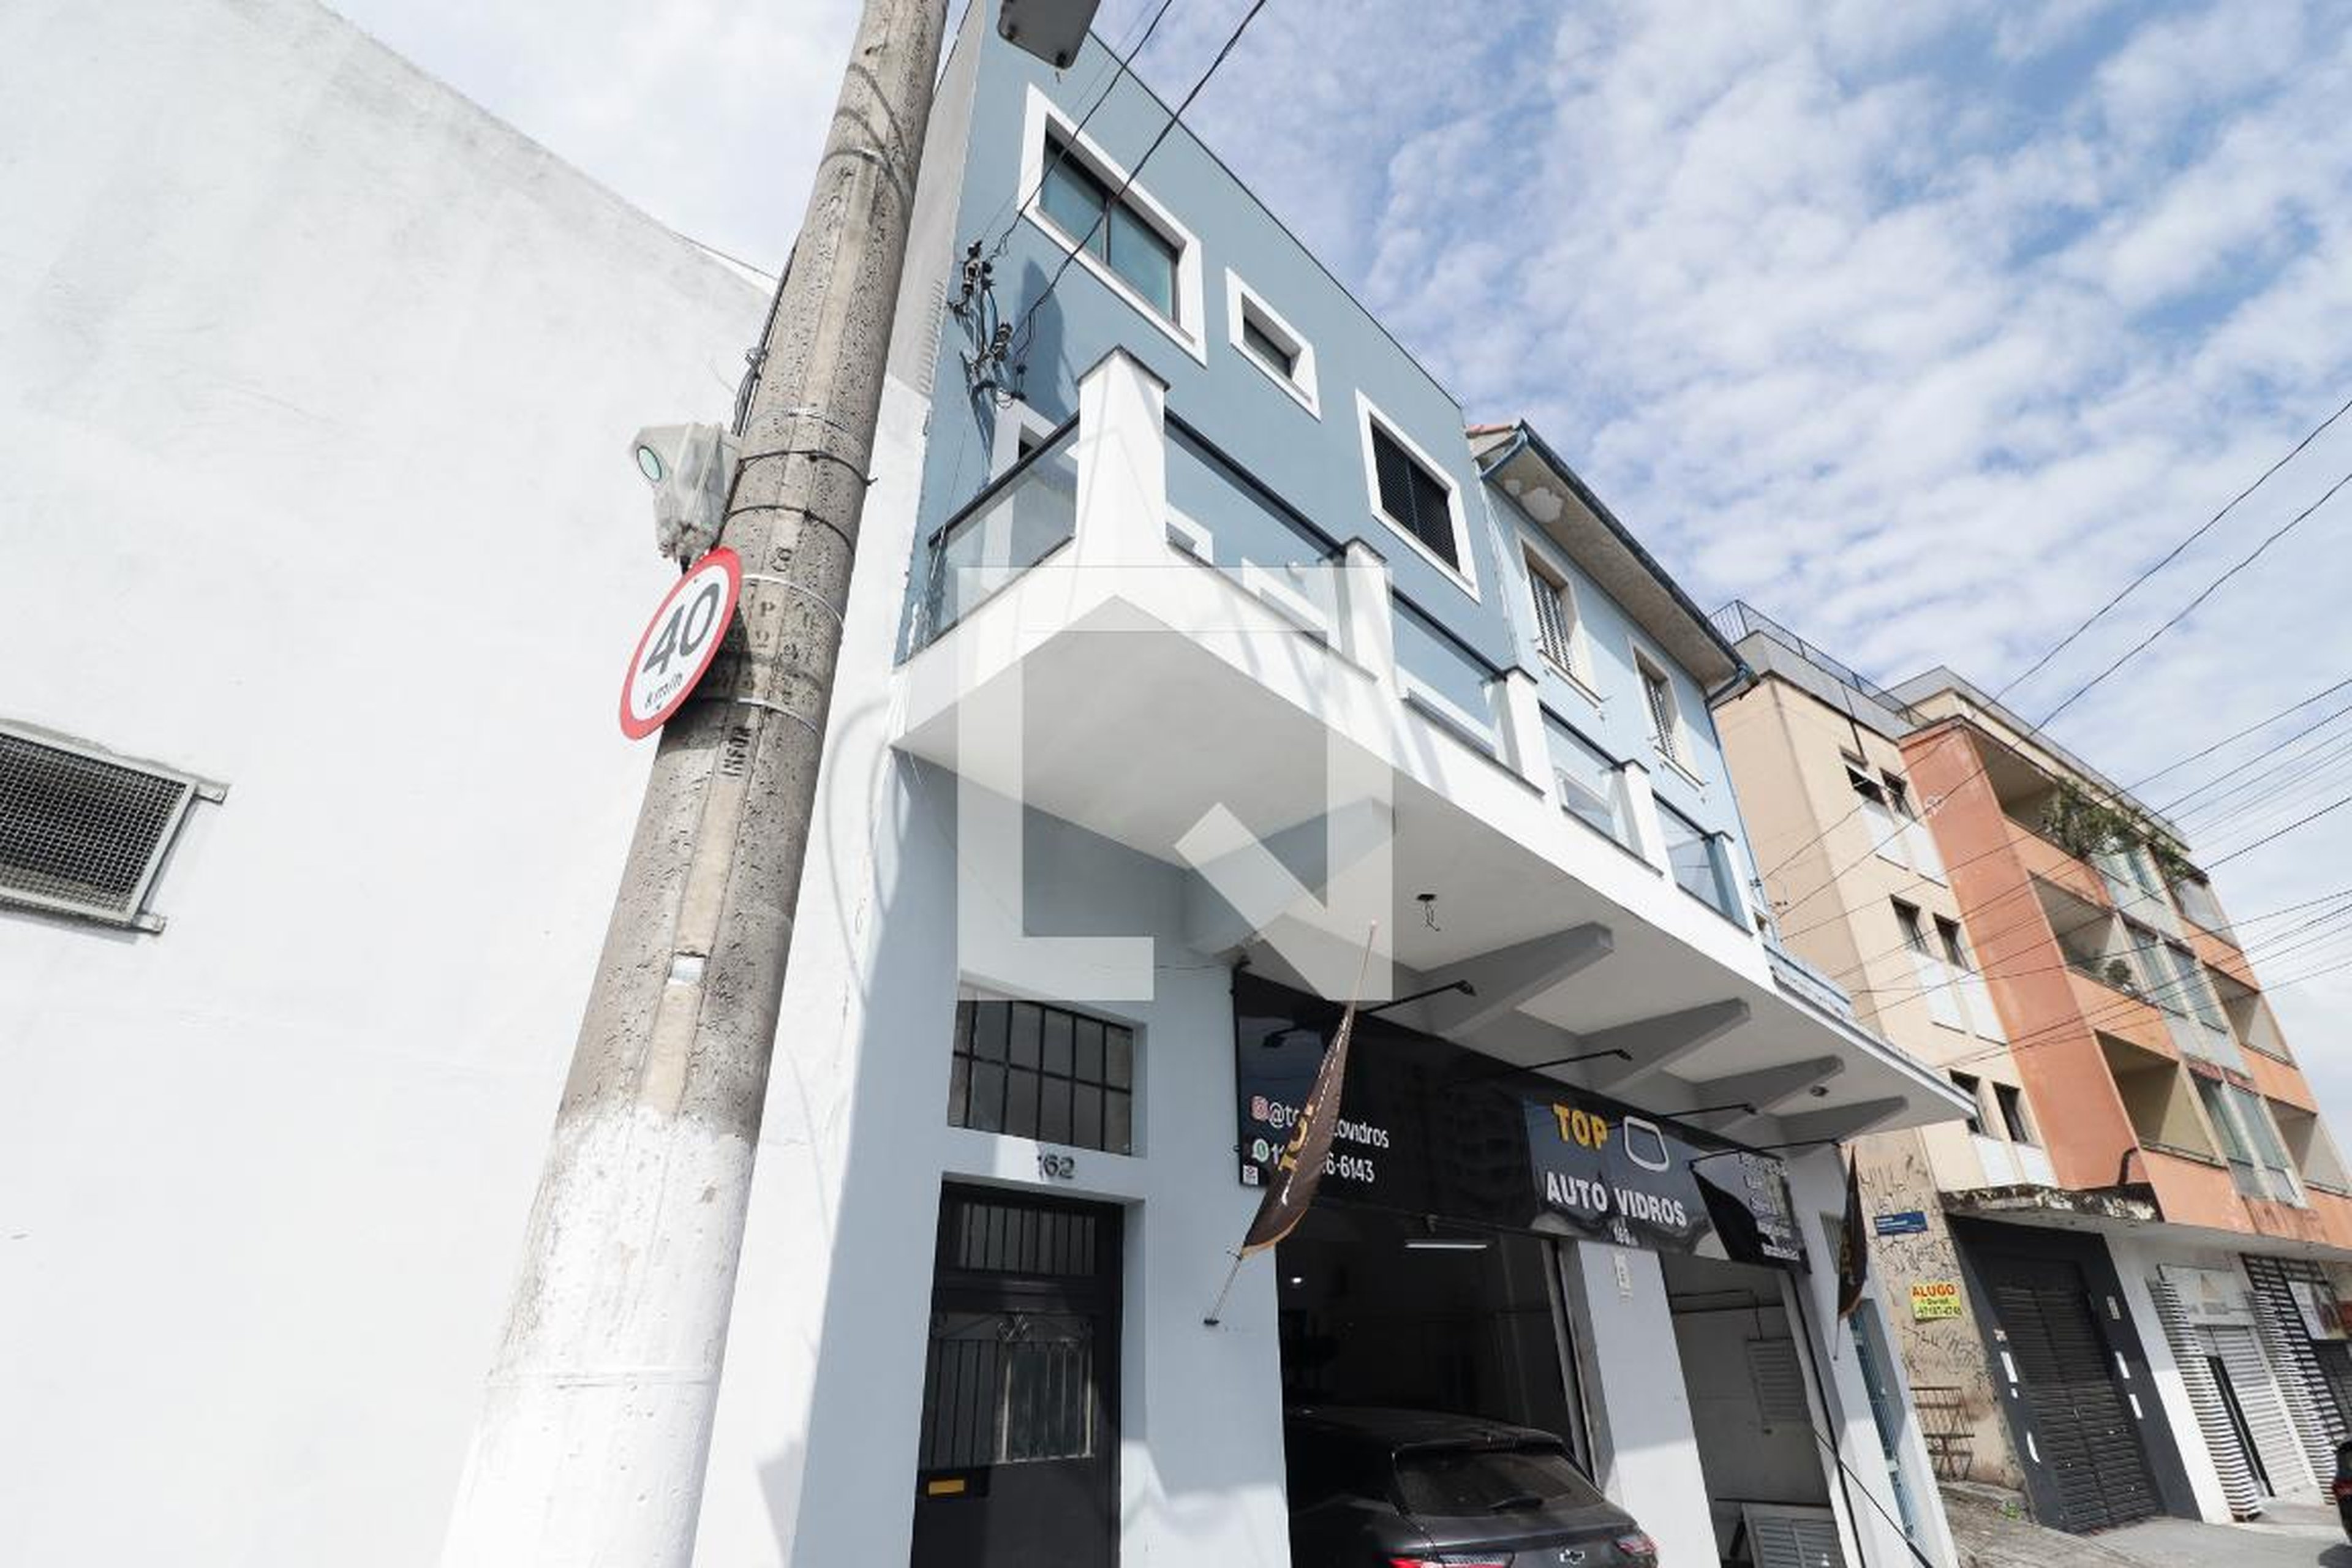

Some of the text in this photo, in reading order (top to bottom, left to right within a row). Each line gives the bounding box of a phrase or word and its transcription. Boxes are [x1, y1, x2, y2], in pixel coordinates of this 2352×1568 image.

[642, 582, 720, 676] 40
[1553, 1102, 1608, 1150] TOP
[1037, 1153, 1075, 1181] 162
[1547, 1170, 1687, 1228] AUTO VIDROS
[1912, 1283, 1955, 1297] ALUGO
